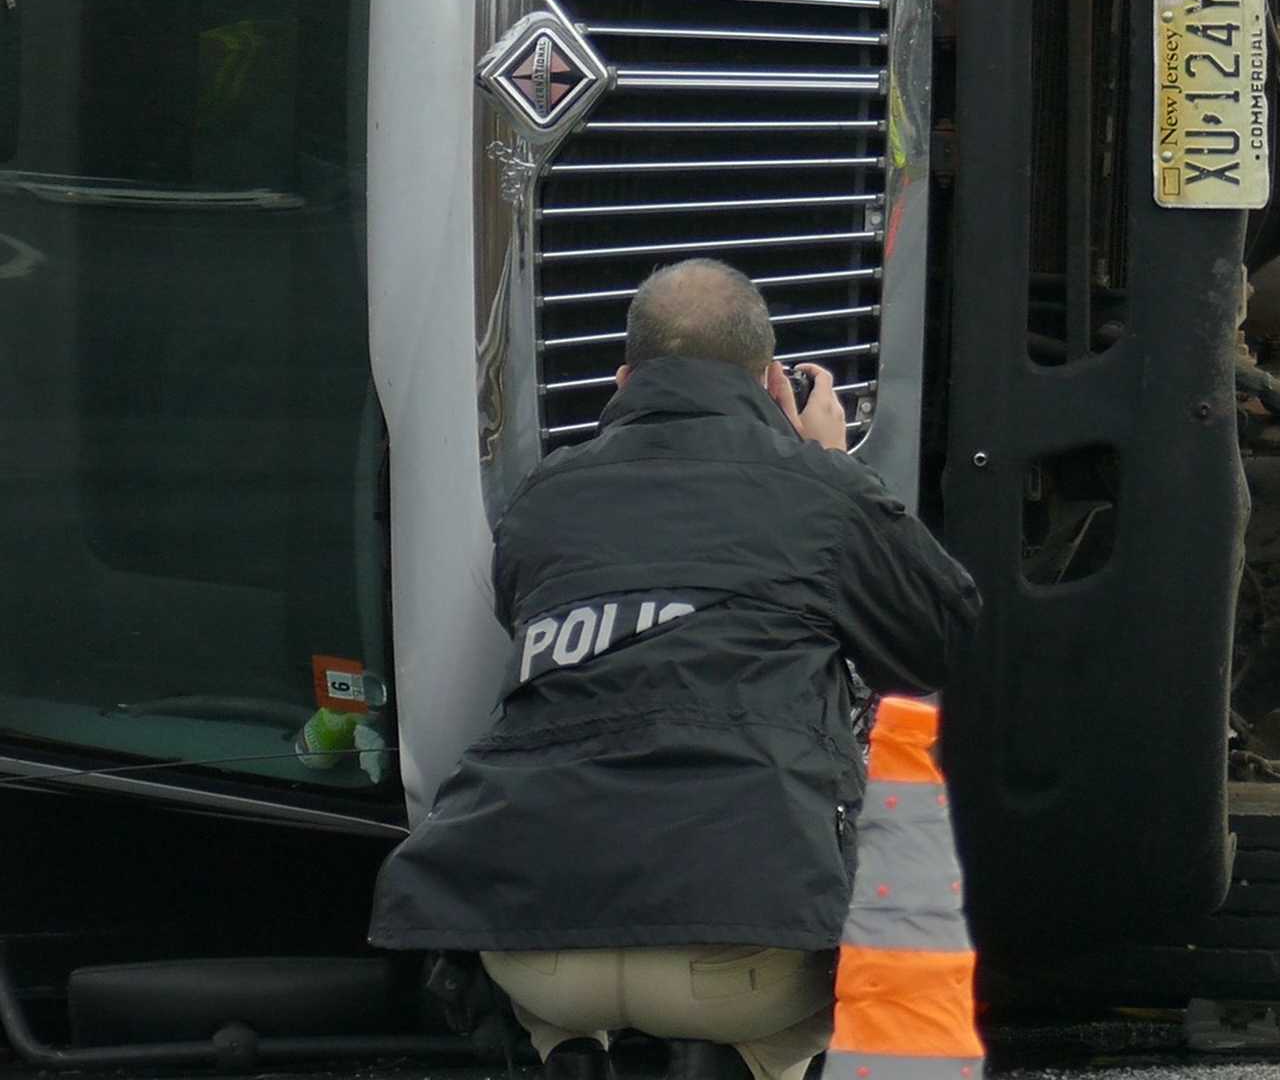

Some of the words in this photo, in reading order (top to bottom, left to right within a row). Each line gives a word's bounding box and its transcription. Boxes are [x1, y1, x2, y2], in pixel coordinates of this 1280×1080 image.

[533, 39, 546, 115] INTERNATIONAL
[1161, 28, 1184, 94] Jersey
[1250, 28, 1264, 150] COMMERCIAL
[1160, 96, 1178, 147] New
